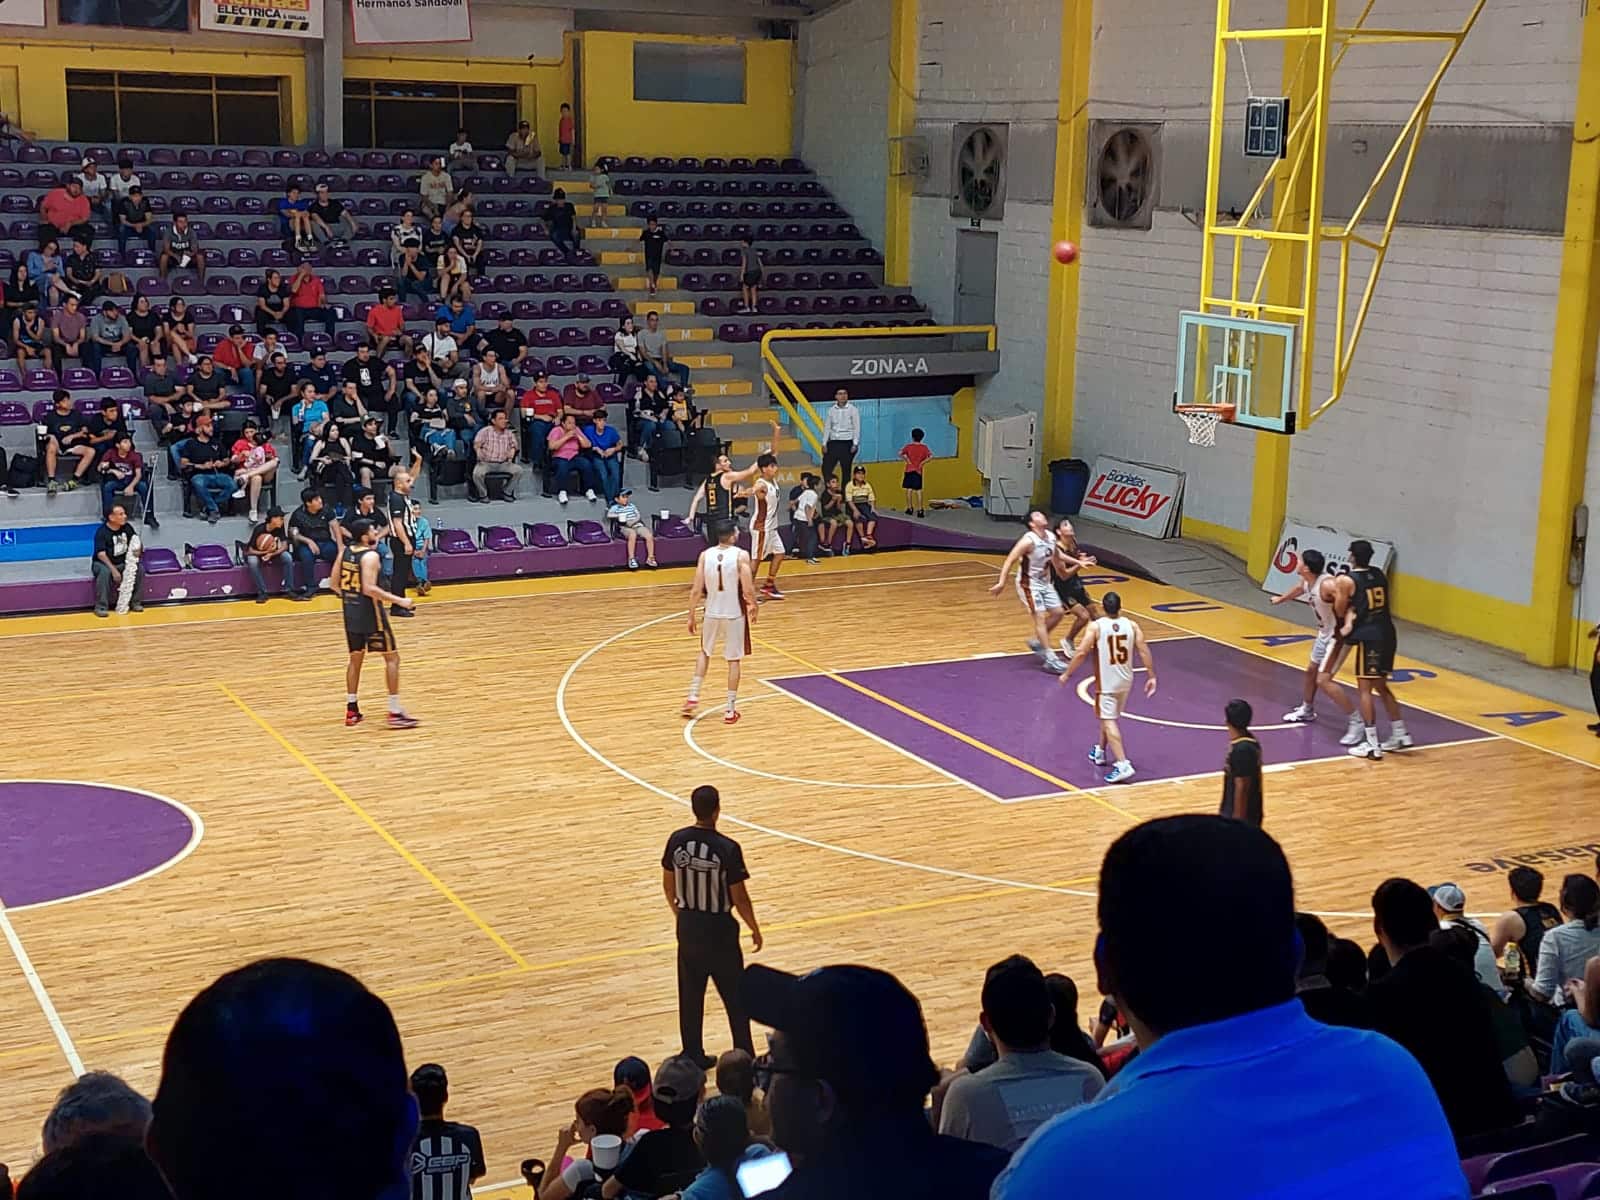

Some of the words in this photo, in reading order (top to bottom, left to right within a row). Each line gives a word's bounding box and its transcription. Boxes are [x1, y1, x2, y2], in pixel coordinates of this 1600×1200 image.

[356, 0, 411, 8] Hermanos
[850, 357, 929, 375] ZONA-A
[1087, 473, 1171, 517] Lucky
[341, 569, 361, 593] 24
[716, 563, 725, 592] 1
[1366, 586, 1385, 610] 19
[1107, 634, 1129, 665] 15
